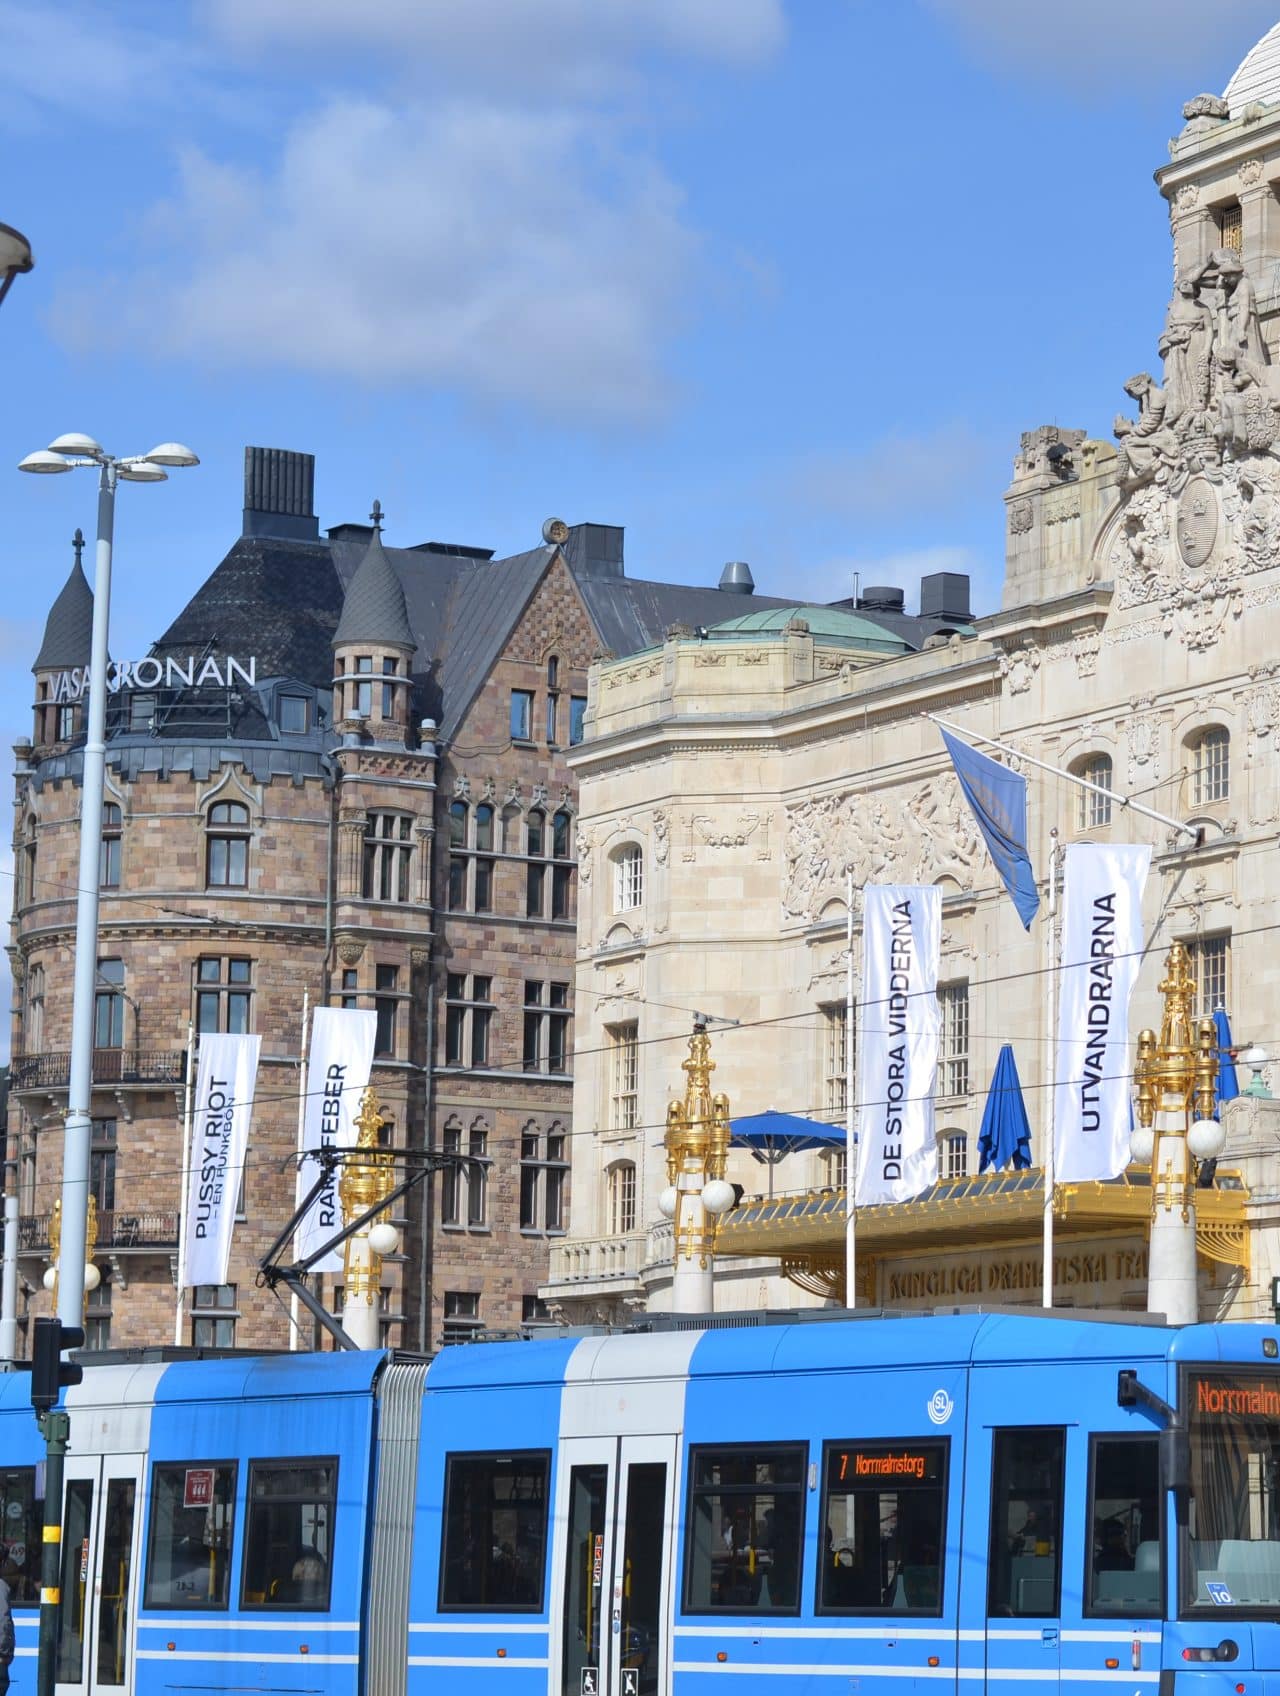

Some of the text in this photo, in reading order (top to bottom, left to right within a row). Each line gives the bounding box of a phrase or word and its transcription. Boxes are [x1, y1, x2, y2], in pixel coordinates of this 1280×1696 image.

[883, 900, 912, 1180] DE STORA VIDDERNA
[1082, 892, 1117, 1132] UTVANDRARNA
[195, 1076, 228, 1239] PUSSY RIOT
[319, 1063, 347, 1228] RAMFEBER
[840, 1453, 924, 1480] 7 Norrmalmstorg
[935, 1396, 946, 1409] SL
[1212, 1591, 1232, 1603] 10
